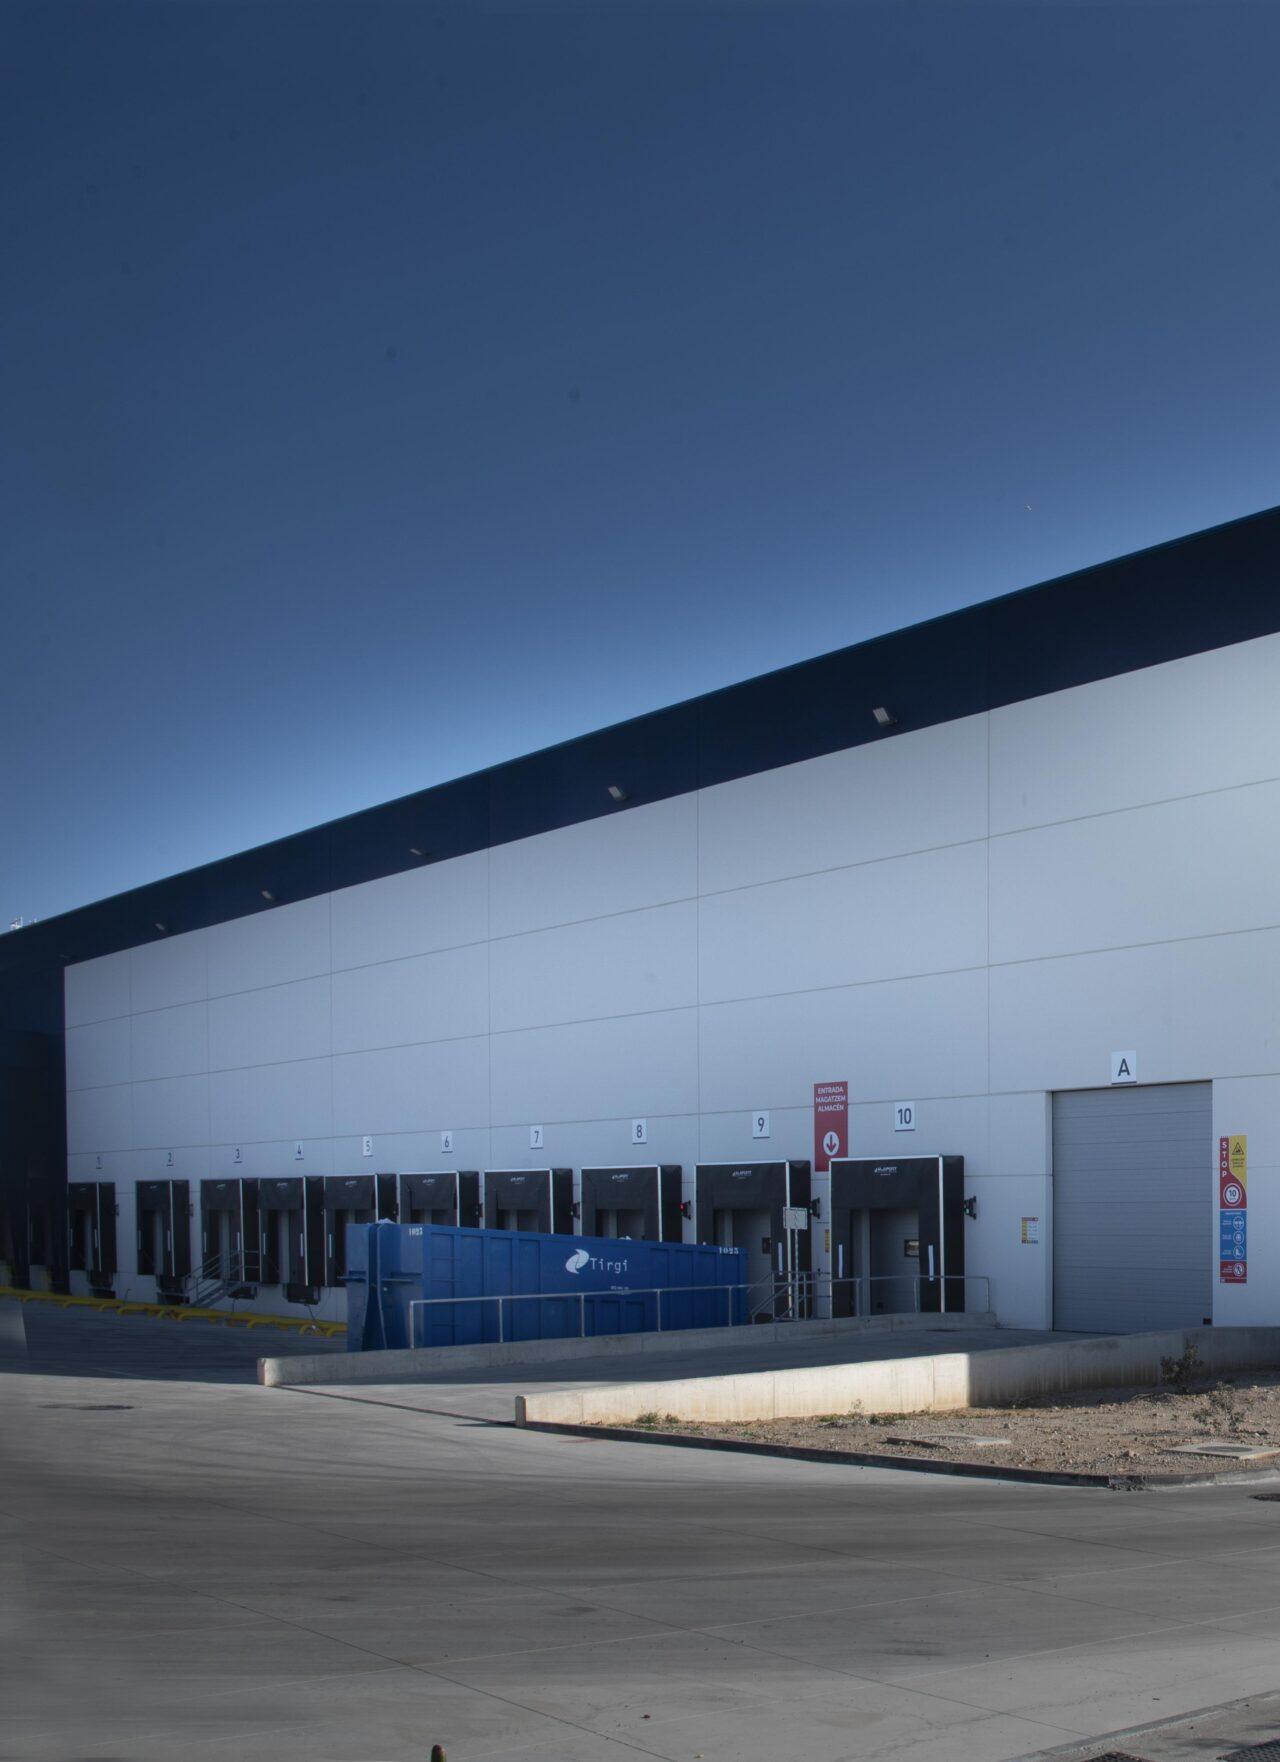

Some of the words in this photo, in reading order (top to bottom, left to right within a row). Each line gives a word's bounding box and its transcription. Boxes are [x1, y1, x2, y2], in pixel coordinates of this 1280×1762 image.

[1117, 1058, 1130, 1077] A
[817, 1086, 844, 1095] ENTRADA
[815, 1095, 846, 1103] MAGATZEM
[817, 1103, 844, 1112] ALMACÉN
[898, 1107, 912, 1125] 10
[757, 1117, 765, 1132] 9
[534, 1130, 540, 1144] 7
[636, 1124, 643, 1139] 8
[366, 1140, 371, 1152] 5
[444, 1135, 450, 1148] 6
[235, 1148, 240, 1159] 3
[297, 1144, 302, 1154] 4
[167, 1152, 172, 1162] 2
[589, 1257, 628, 1273] Tirgi
